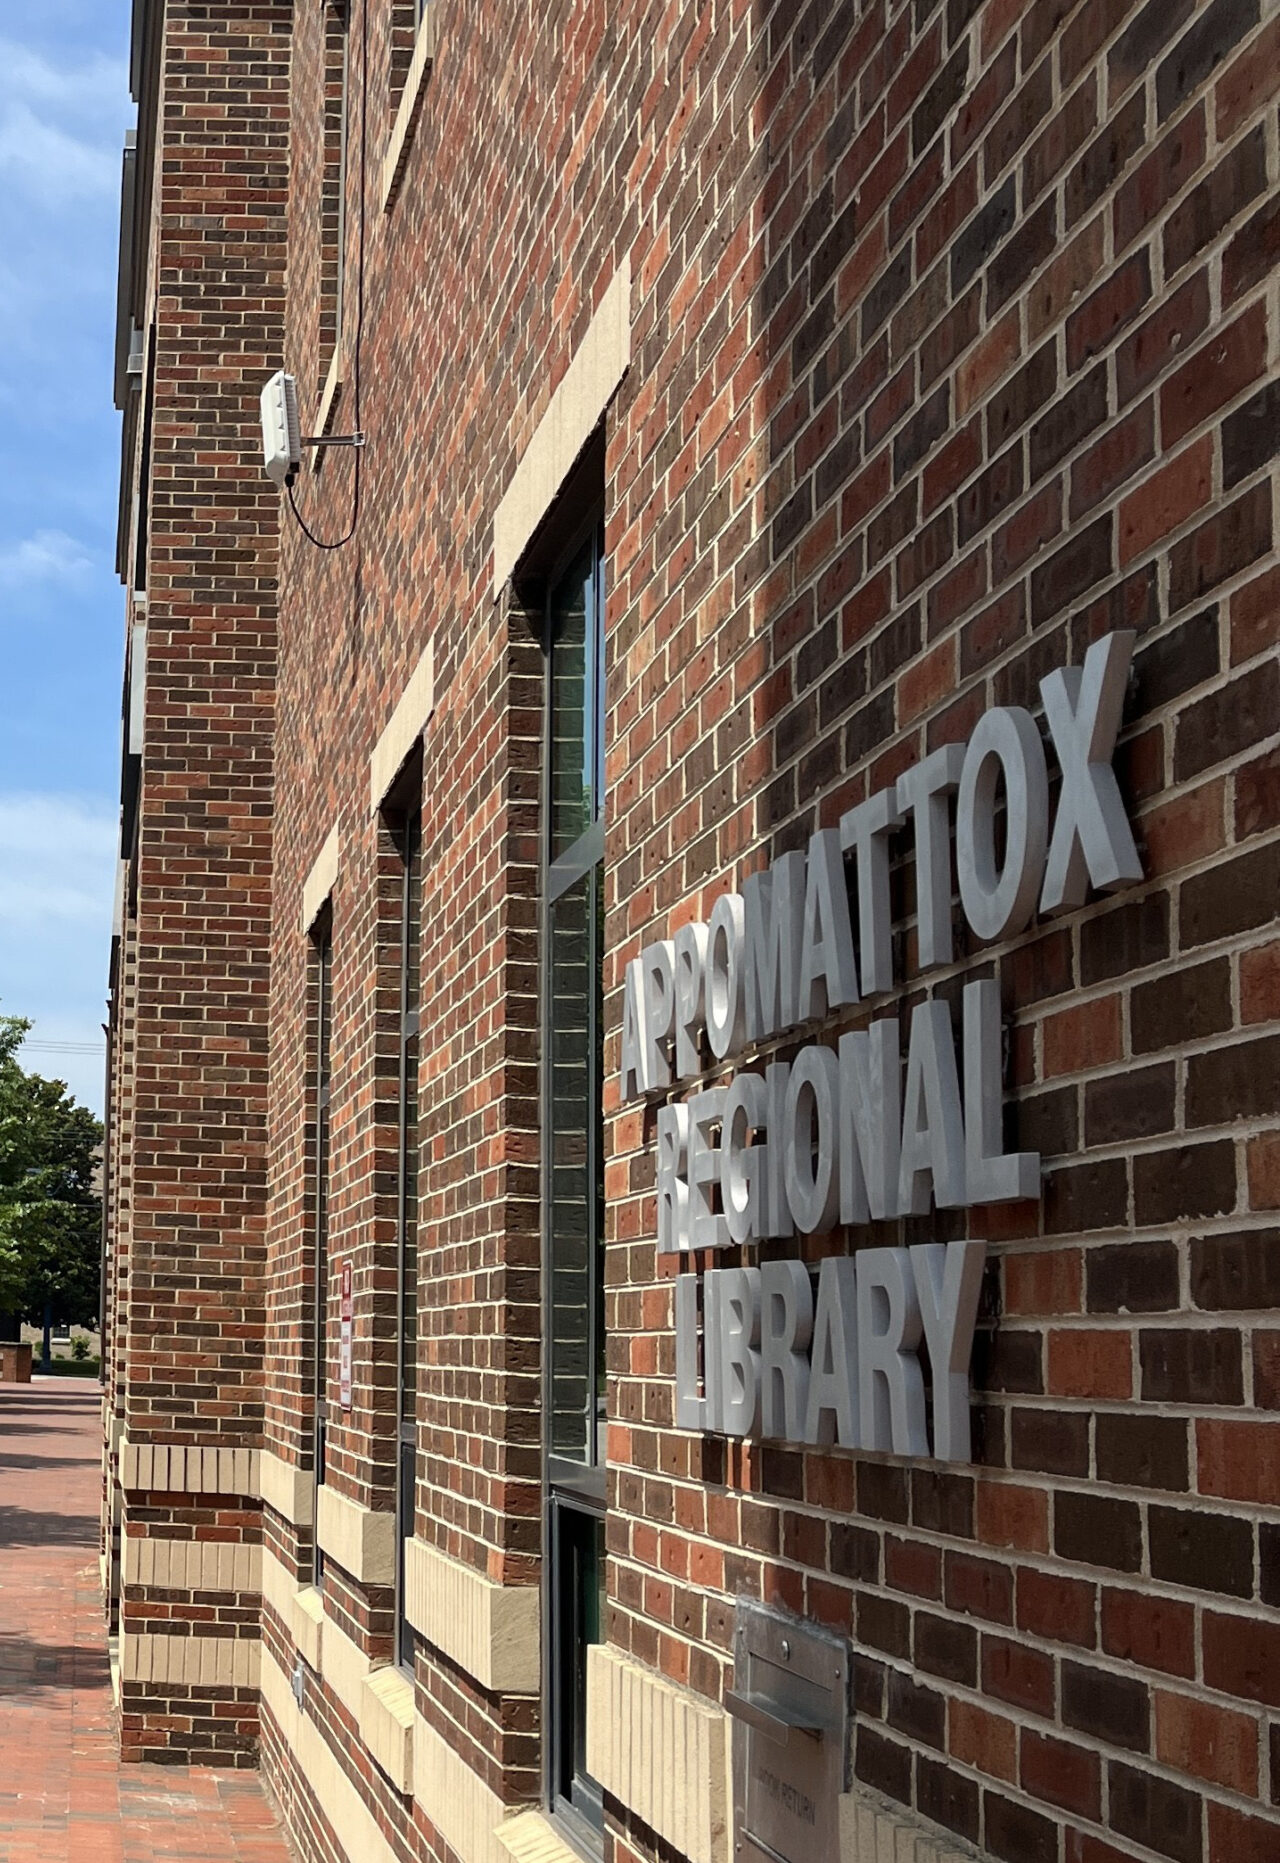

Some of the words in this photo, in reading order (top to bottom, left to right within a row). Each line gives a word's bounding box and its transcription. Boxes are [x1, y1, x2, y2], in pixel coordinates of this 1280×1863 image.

[620, 629, 1145, 1101] APPOMATTOX
[657, 979, 1042, 1252] REGIONAL
[675, 1240, 987, 1463] LIBRARY
